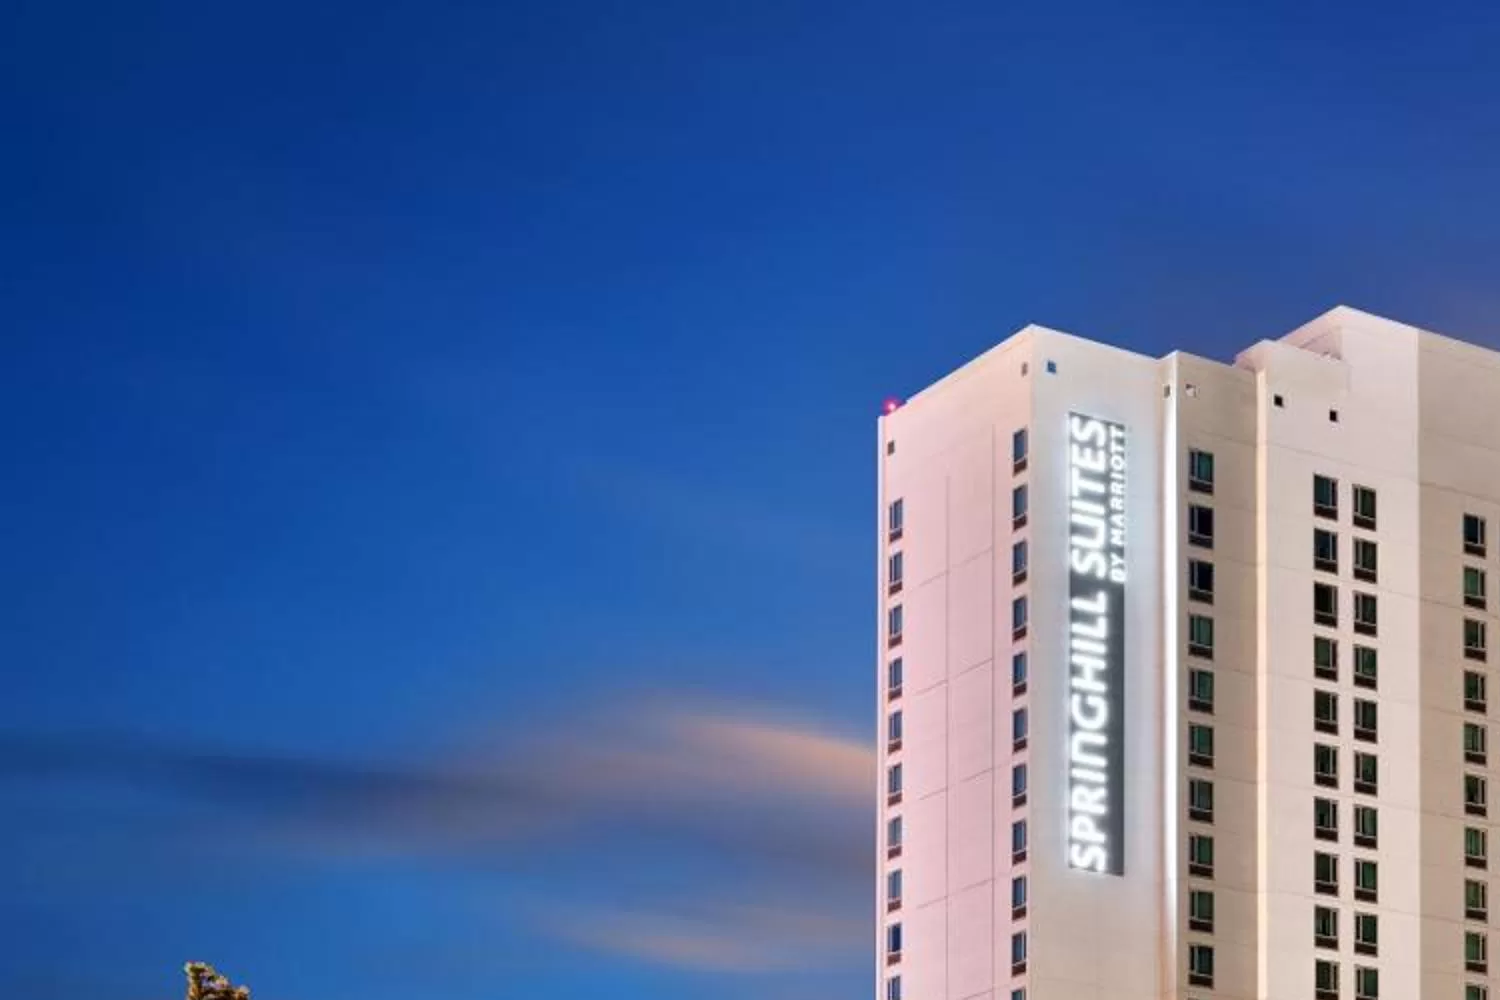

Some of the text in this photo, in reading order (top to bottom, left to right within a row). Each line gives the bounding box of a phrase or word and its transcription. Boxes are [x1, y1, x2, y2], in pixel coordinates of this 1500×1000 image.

[1070, 416, 1107, 872] SPRINGHILL SUITES
[1108, 425, 1126, 582] BY MARRIOTT
